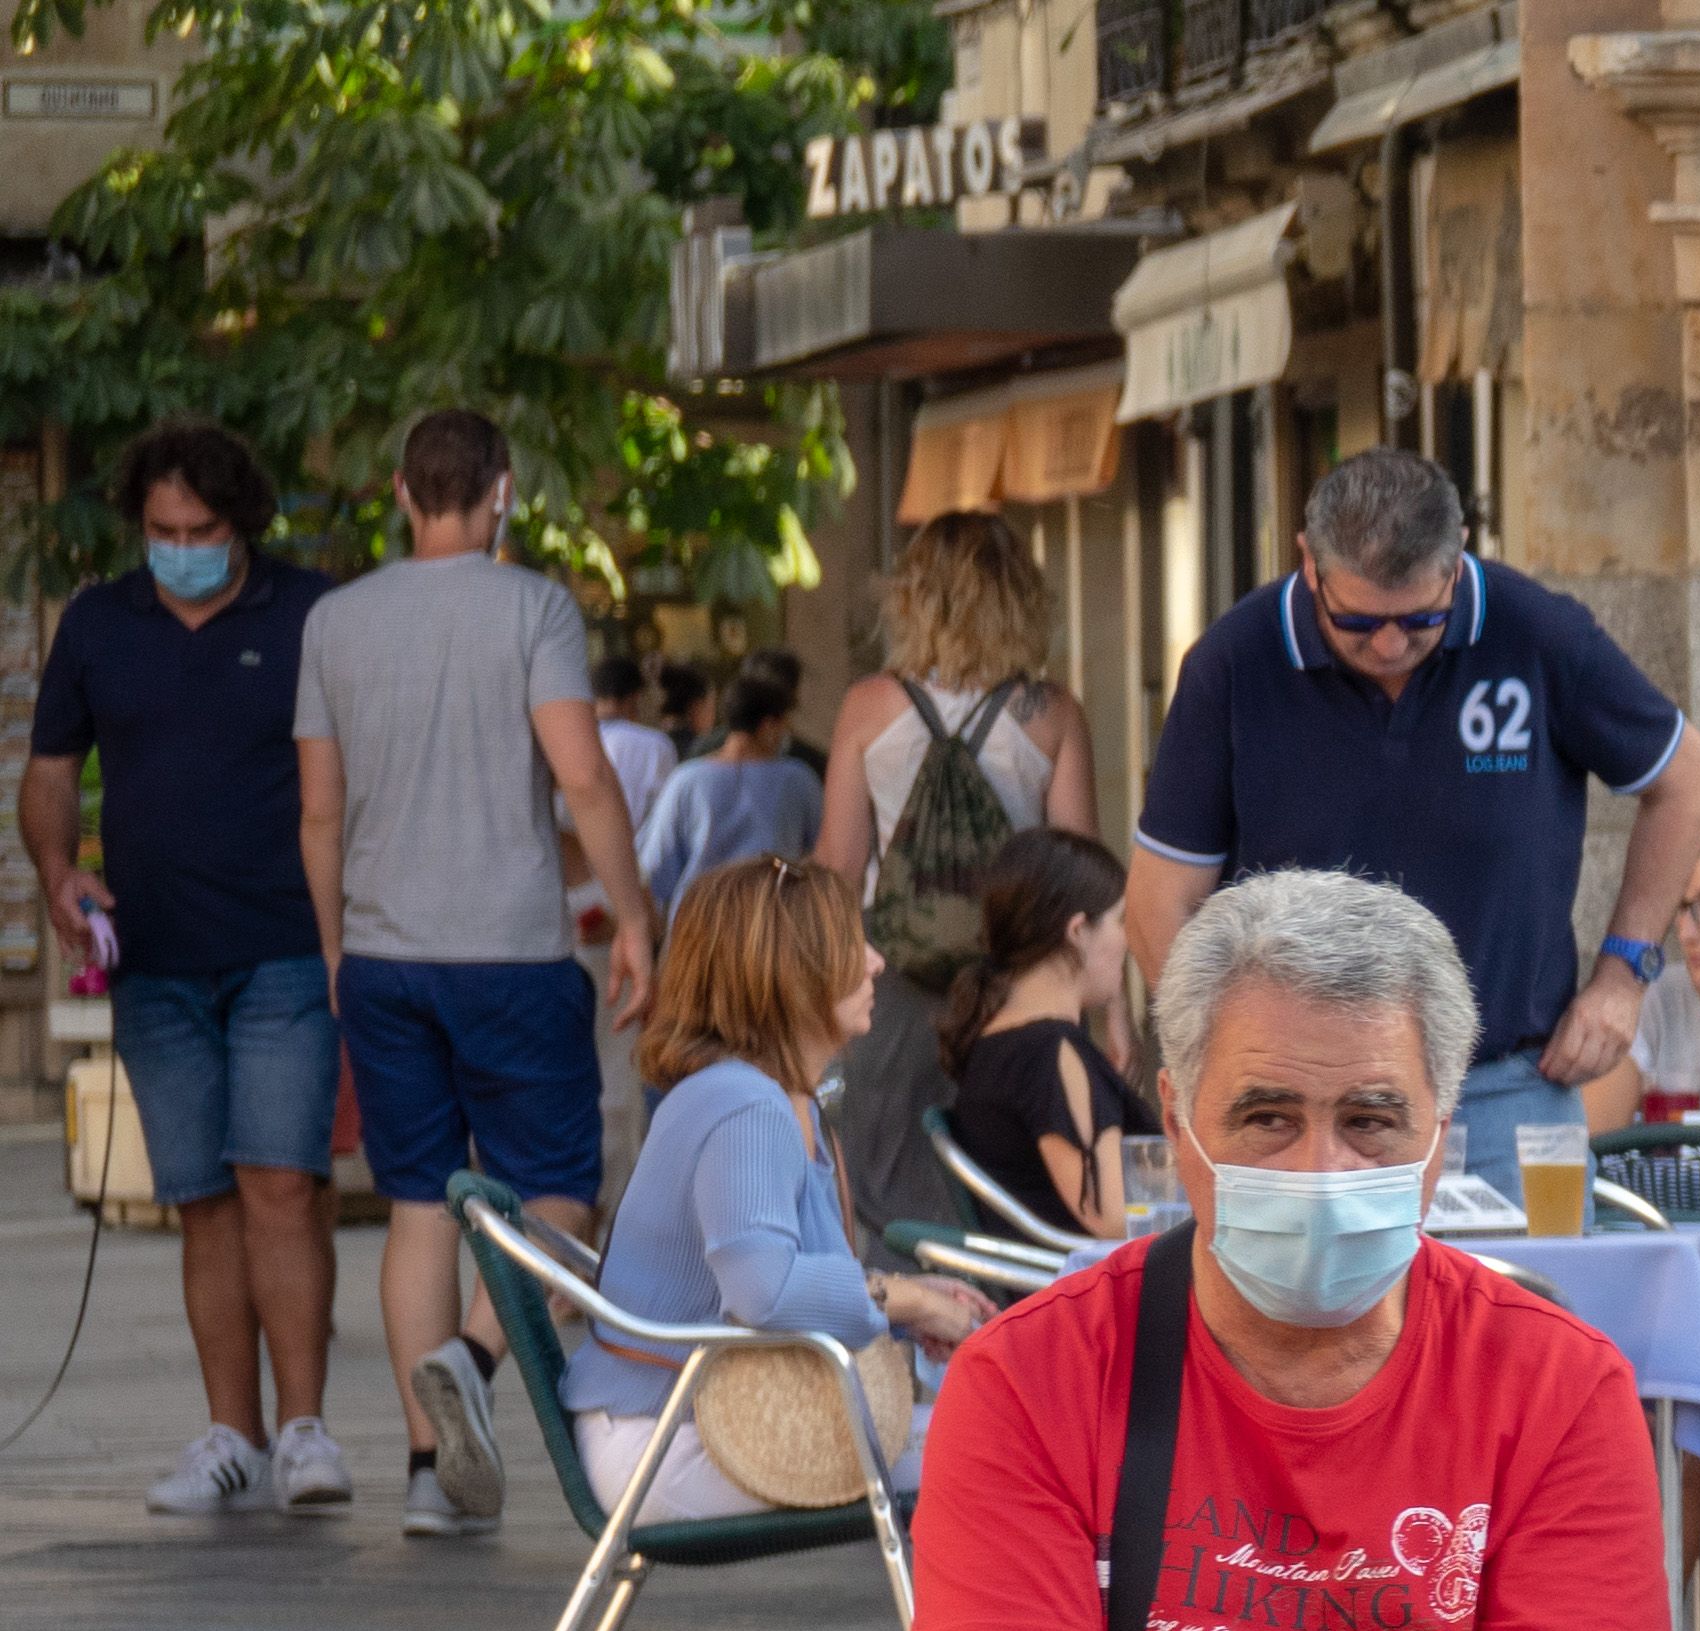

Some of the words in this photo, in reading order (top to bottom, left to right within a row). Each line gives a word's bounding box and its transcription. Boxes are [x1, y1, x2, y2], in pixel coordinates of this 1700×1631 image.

[805, 118, 1024, 220] ZAPATOS
[1460, 678, 1531, 752] 62
[1150, 1541, 1415, 1631] HIKING
[1215, 1543, 1329, 1582] Mountain
